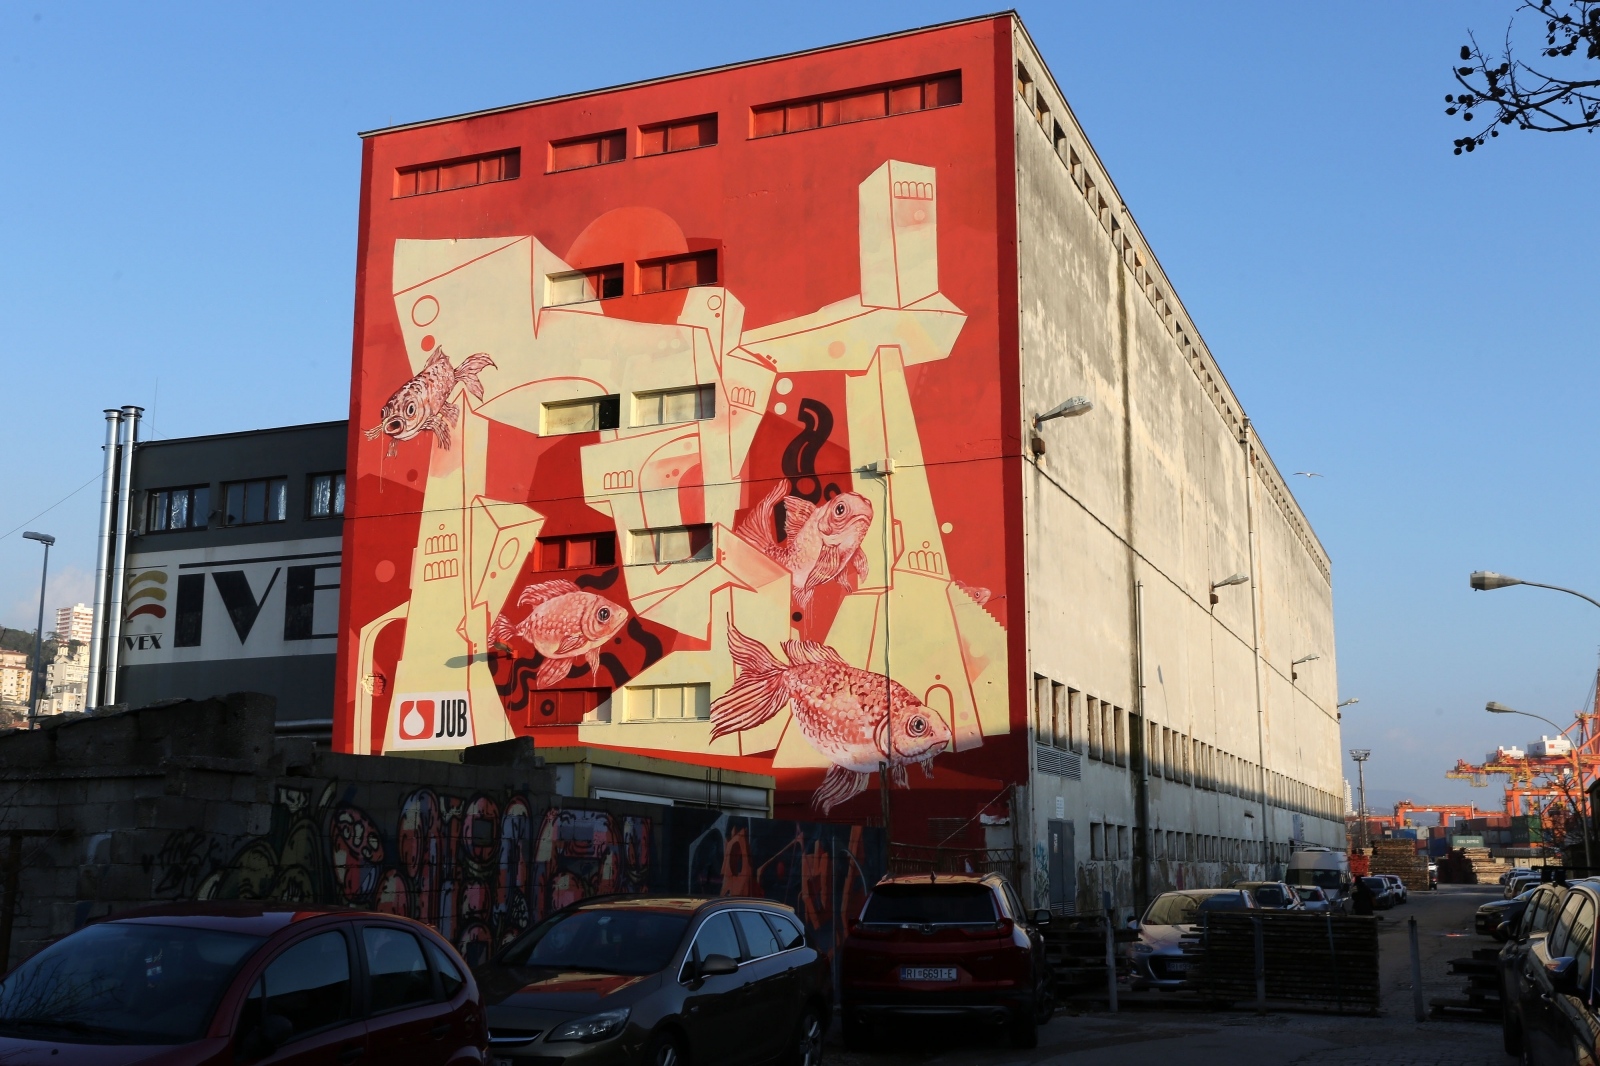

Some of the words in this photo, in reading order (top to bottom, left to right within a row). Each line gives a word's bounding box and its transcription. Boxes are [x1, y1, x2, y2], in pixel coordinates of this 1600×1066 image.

[435, 699, 468, 738] JUB
[906, 968, 916, 979] RI
[922, 968, 953, 979] 6691-E
